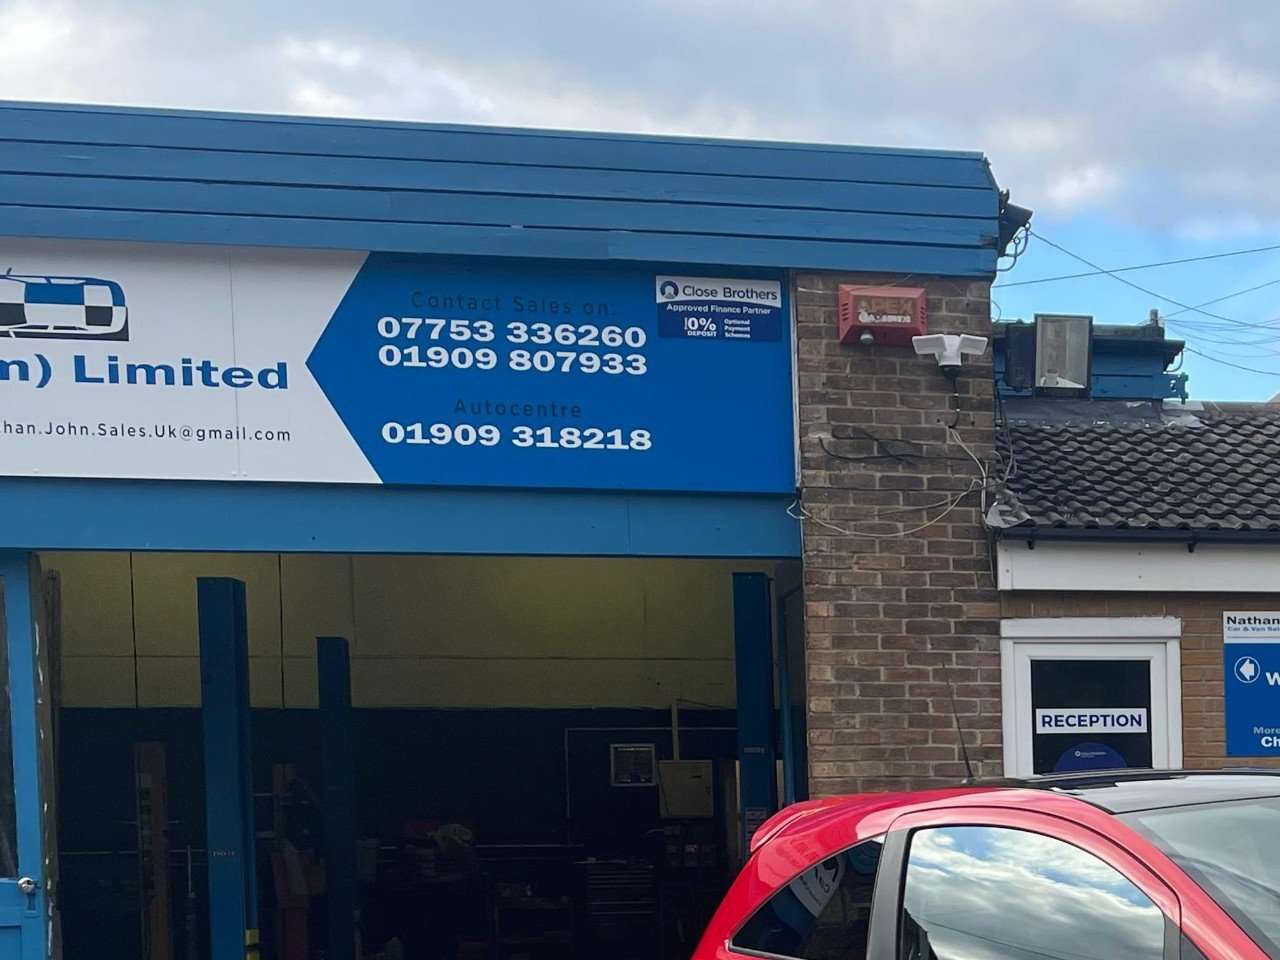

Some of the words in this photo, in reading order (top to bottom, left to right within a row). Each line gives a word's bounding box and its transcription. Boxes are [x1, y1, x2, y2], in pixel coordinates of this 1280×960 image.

[410, 291, 500, 312] Contact
[512, 296, 572, 315] Sales
[682, 285, 719, 298] Close
[723, 286, 778, 301] Brothers
[666, 303, 709, 315] Approved
[710, 304, 741, 315] Finance
[742, 306, 771, 316] Partner
[377, 316, 496, 342] 07753
[506, 321, 647, 348] 336260
[378, 344, 498, 370] 01909
[508, 349, 648, 375] 807933
[73, 355, 289, 390] Limited
[453, 399, 582, 419] Autocentre
[0, 420, 291, 442] han.John.Sales.Uk@gmail.com
[381, 421, 500, 446] 01909
[511, 426, 652, 450] 318218
[1226, 615, 1280, 625] Nathan
[1041, 714, 1142, 728] RECEPTION
